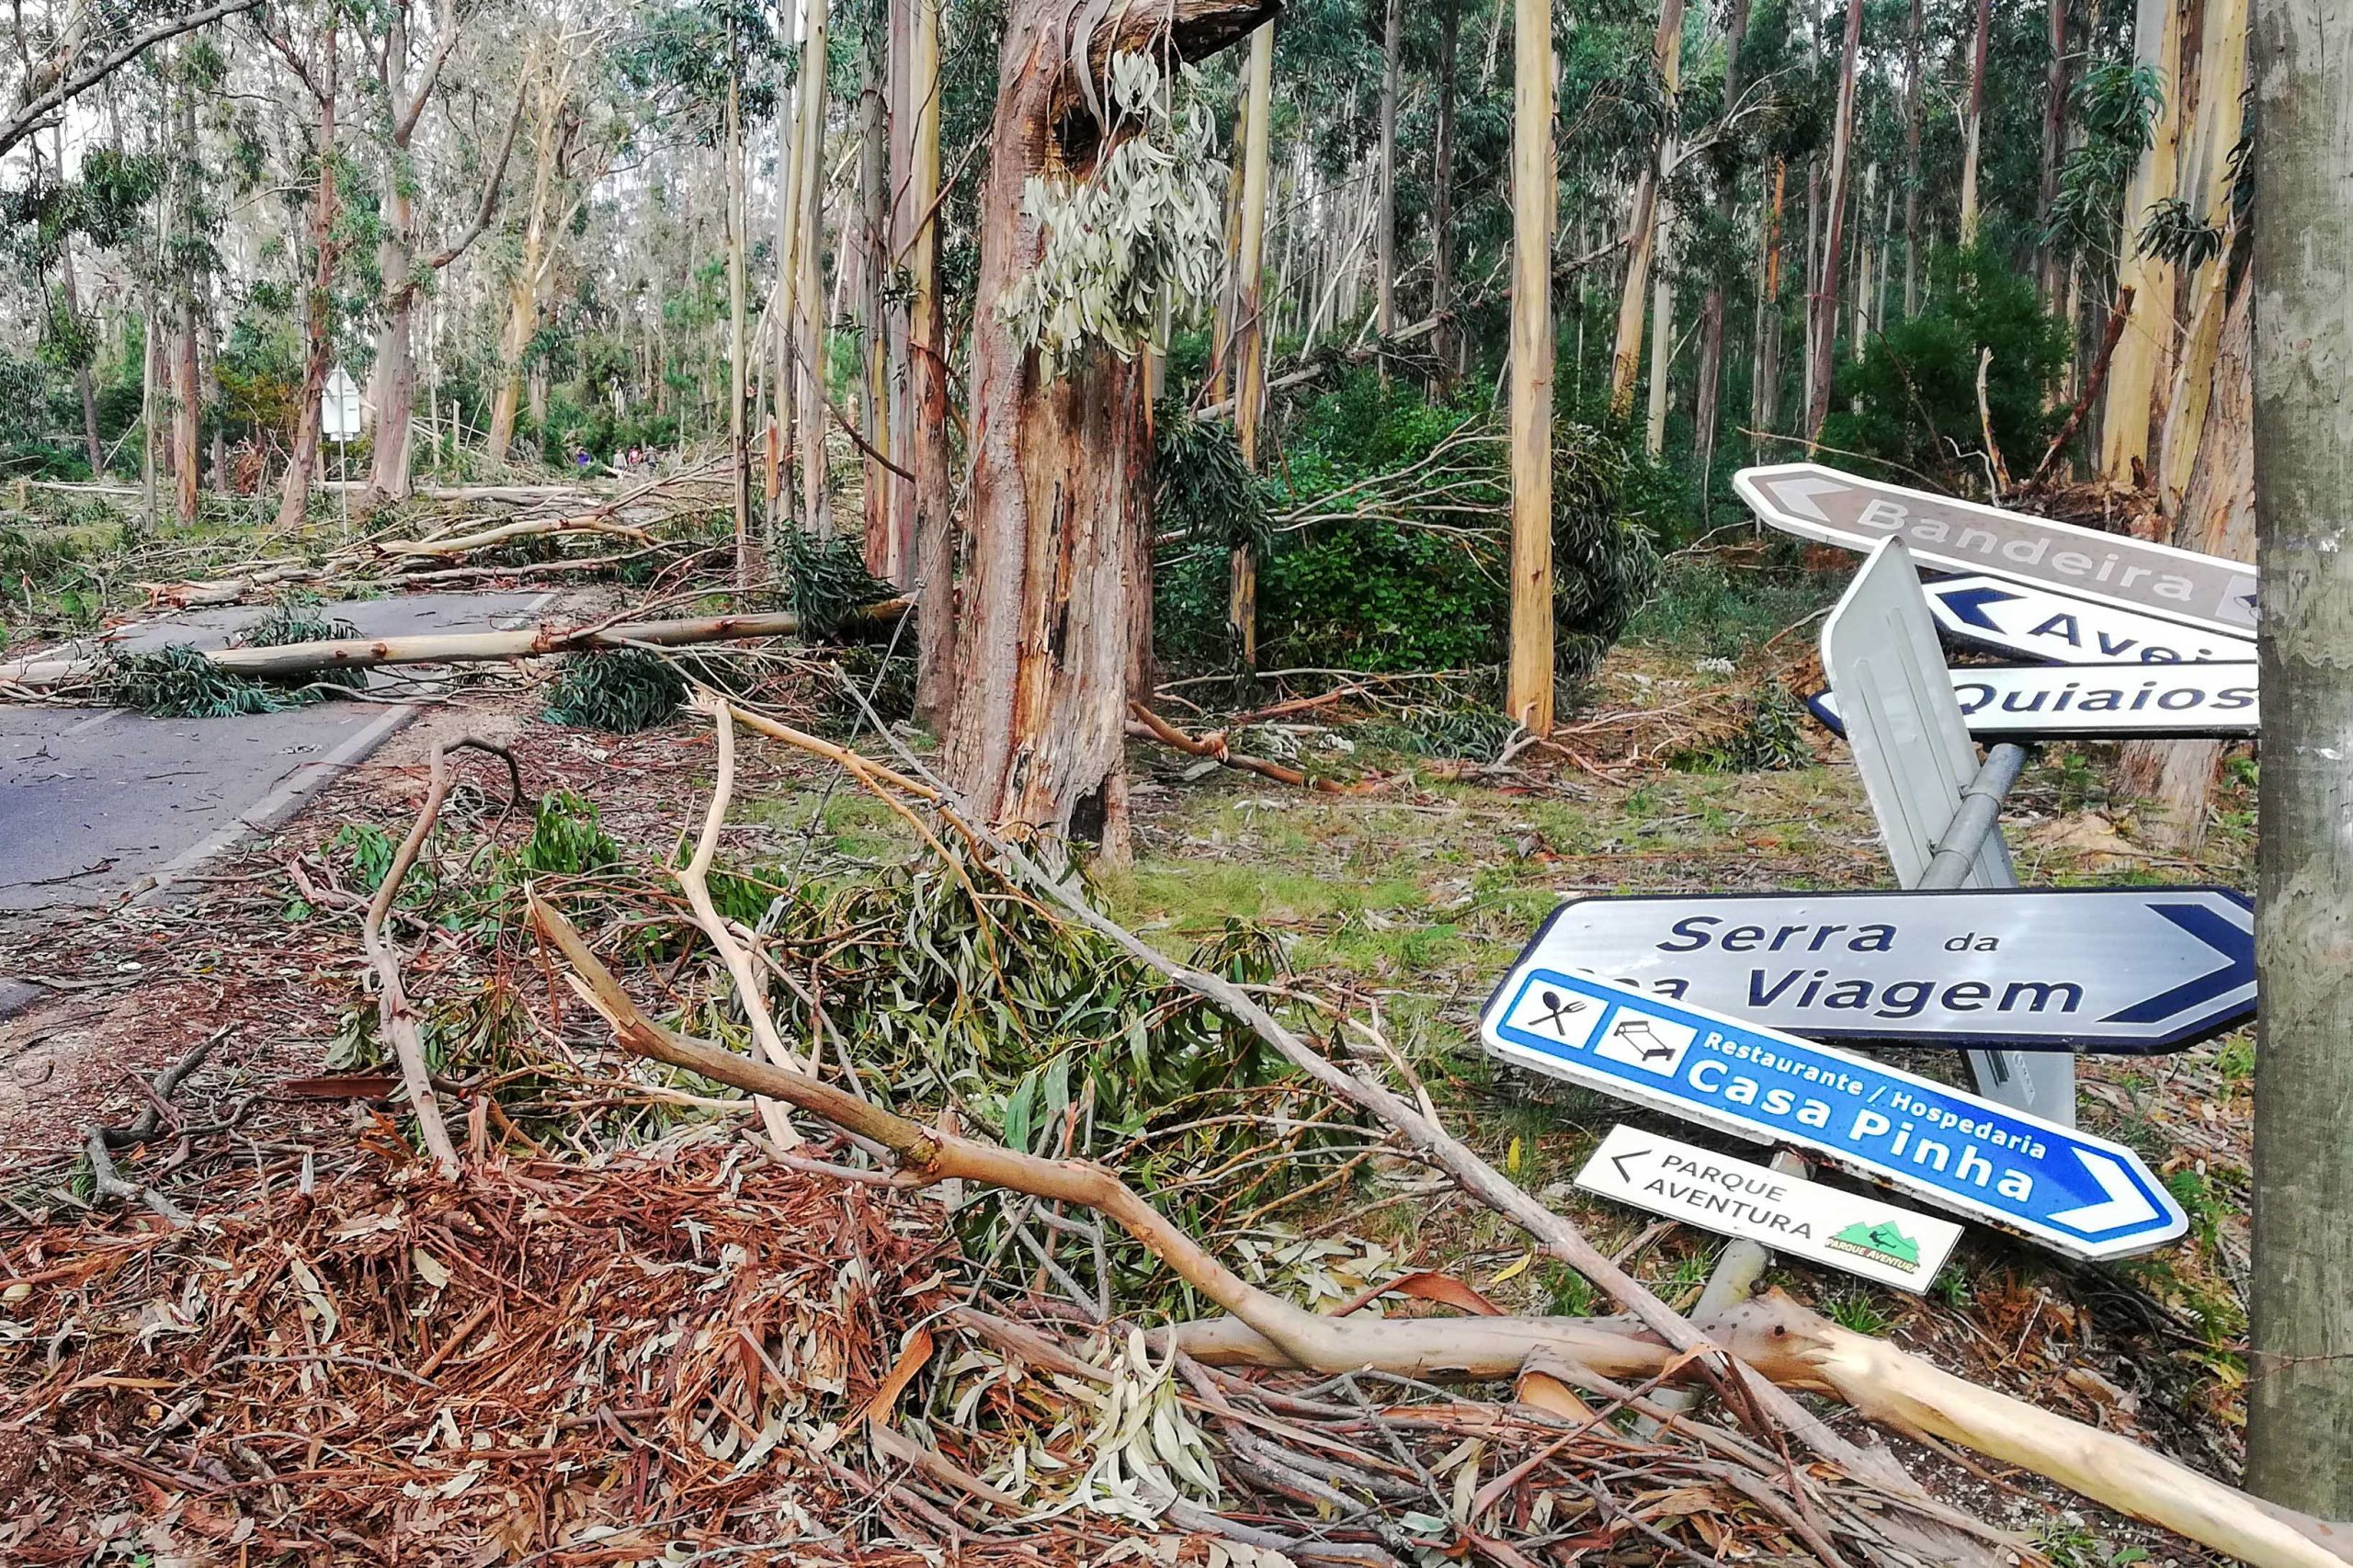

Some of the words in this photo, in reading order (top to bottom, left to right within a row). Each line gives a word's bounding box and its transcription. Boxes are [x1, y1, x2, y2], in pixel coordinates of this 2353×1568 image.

[1857, 498, 2195, 602] Bandeira
[1953, 681, 2259, 716] Quiaios
[1655, 915, 1898, 952] Serra
[1944, 932, 1999, 952] da
[1747, 969, 2084, 1018] Viagem
[1703, 1030, 1865, 1096] Restaurante
[1890, 1091, 2047, 1160] Hospedaria
[1688, 1059, 1832, 1130] Casa
[1848, 1108, 2034, 1203] Pinha
[1661, 1154, 1787, 1202] PARQUE
[1643, 1178, 1813, 1239] AVENTURA
[1824, 1238, 1866, 1256] PARQUE
[1866, 1251, 1919, 1274] AVENTURA
